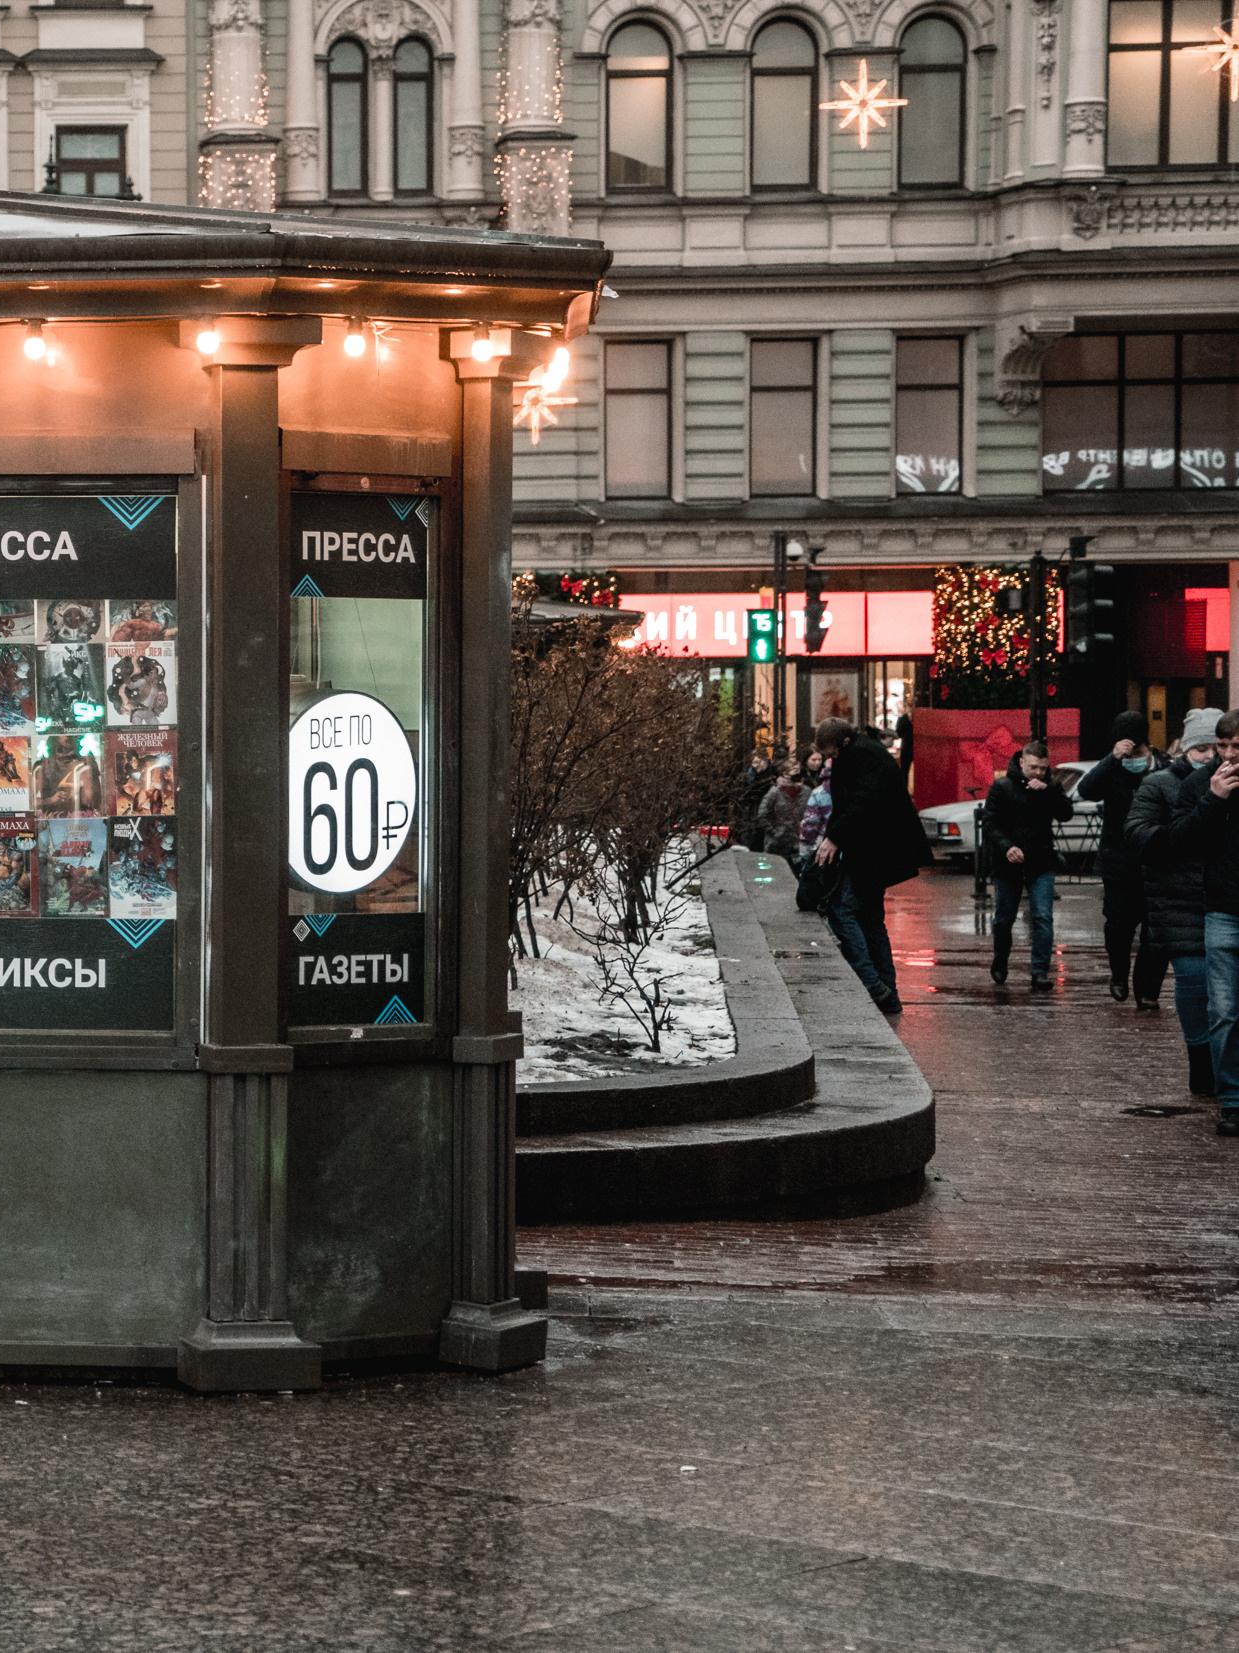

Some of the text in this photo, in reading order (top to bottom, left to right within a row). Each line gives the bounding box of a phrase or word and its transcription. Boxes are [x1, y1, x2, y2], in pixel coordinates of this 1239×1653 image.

[301, 530, 416, 563] ПРЕССА
[633, 605, 833, 645] ИЙ ЦТР
[117, 731, 168, 740] ЖЕЛЕЗНЫЙ
[123, 739, 163, 748] ЧЕЛОВЕК
[310, 714, 372, 750] ВСЕ ПО
[298, 953, 409, 986] ГАЗЕТЫ
